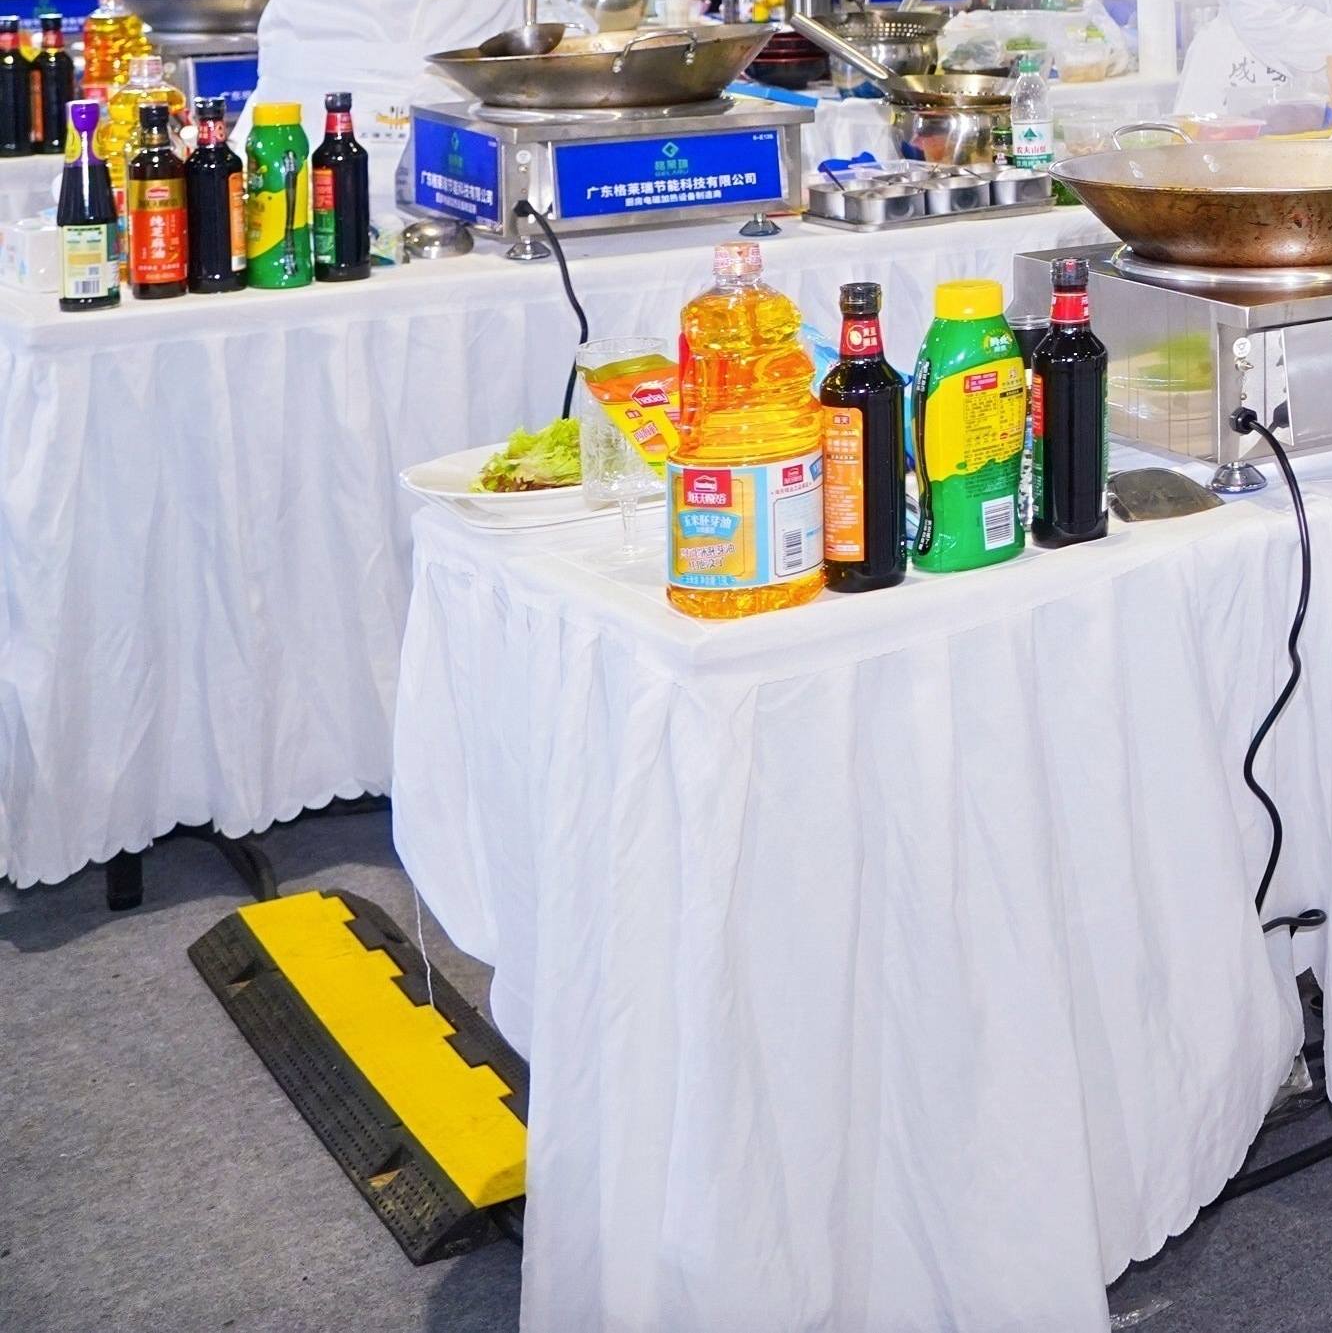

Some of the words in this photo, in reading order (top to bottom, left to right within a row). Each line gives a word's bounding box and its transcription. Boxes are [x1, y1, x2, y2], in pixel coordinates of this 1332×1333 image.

[586, 172, 757, 200] 广东格莱瑞节能科技有限公司
